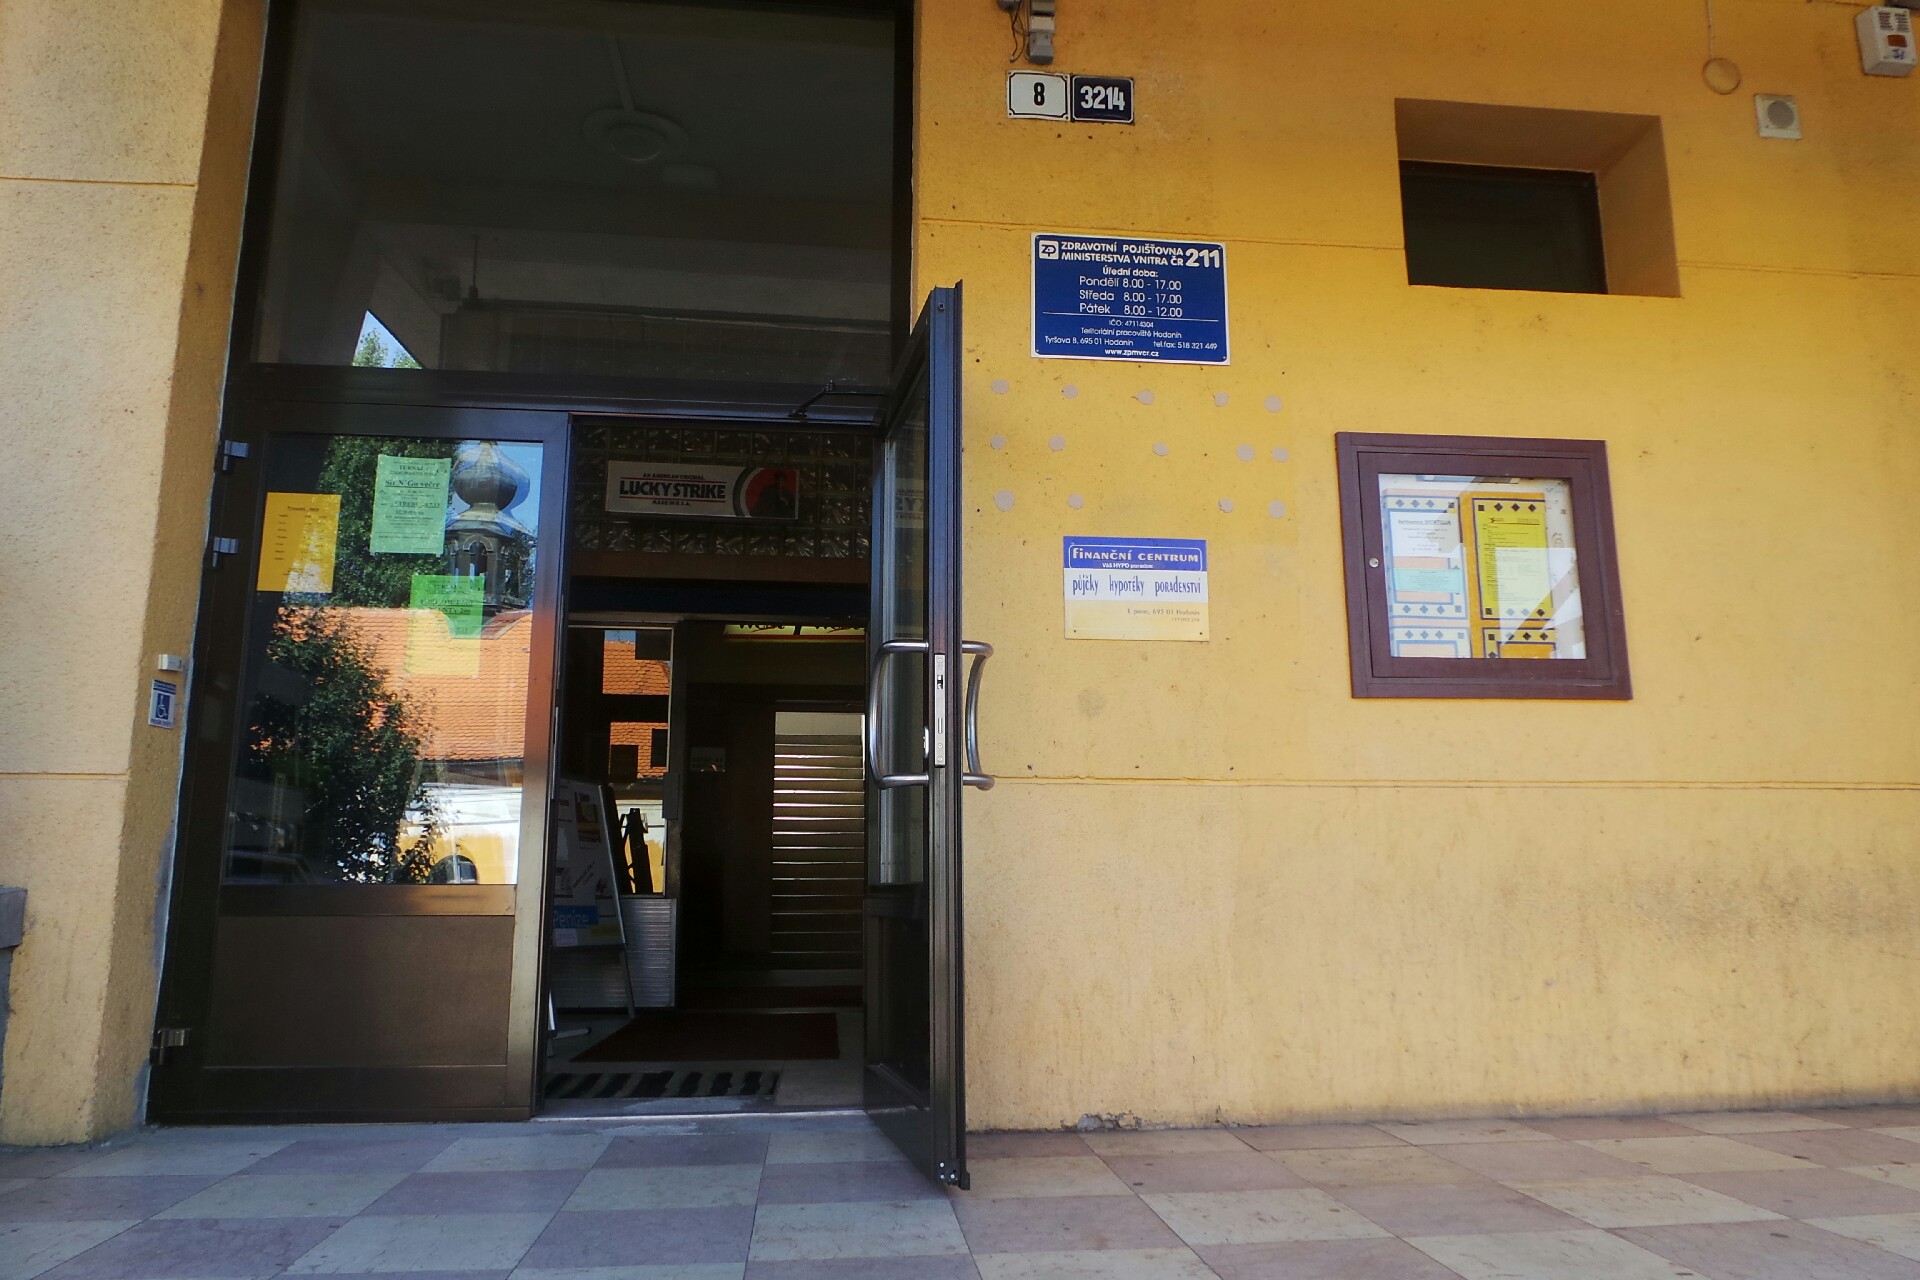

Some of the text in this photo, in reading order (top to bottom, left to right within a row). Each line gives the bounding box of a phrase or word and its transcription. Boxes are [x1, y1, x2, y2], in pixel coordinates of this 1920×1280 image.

[1034, 82, 1045, 106] 8
[1080, 86, 1125, 111] 3214
[1061, 241, 1184, 255] ZDRAVOTNÍ POJIŠŤOVNA
[1061, 252, 1184, 266] MINISTERSTVA VNITRA ČR
[1185, 248, 1220, 268] 211
[1103, 265, 1159, 277] Úřední doba:
[1080, 276, 1119, 287] Pondělí
[1122, 278, 1144, 288] 8.00
[1155, 280, 1182, 290] 17.00
[1080, 289, 1115, 300] Středa
[1123, 292, 1145, 302] 8.00
[1155, 294, 1182, 304] 17.00
[1080, 302, 1111, 313] Pátek
[1124, 305, 1145, 315] 8.00
[1156, 307, 1182, 317] 12.00
[1045, 335, 1071, 344] Tyršova
[1116, 328, 1152, 337] pracoviště
[1104, 349, 1159, 357] www.zpmvcr.cz
[1204, 342, 1218, 350] 449
[620, 480, 726, 499] LUCKY STRIKE
[1137, 553, 1199, 562] CENTRUM
